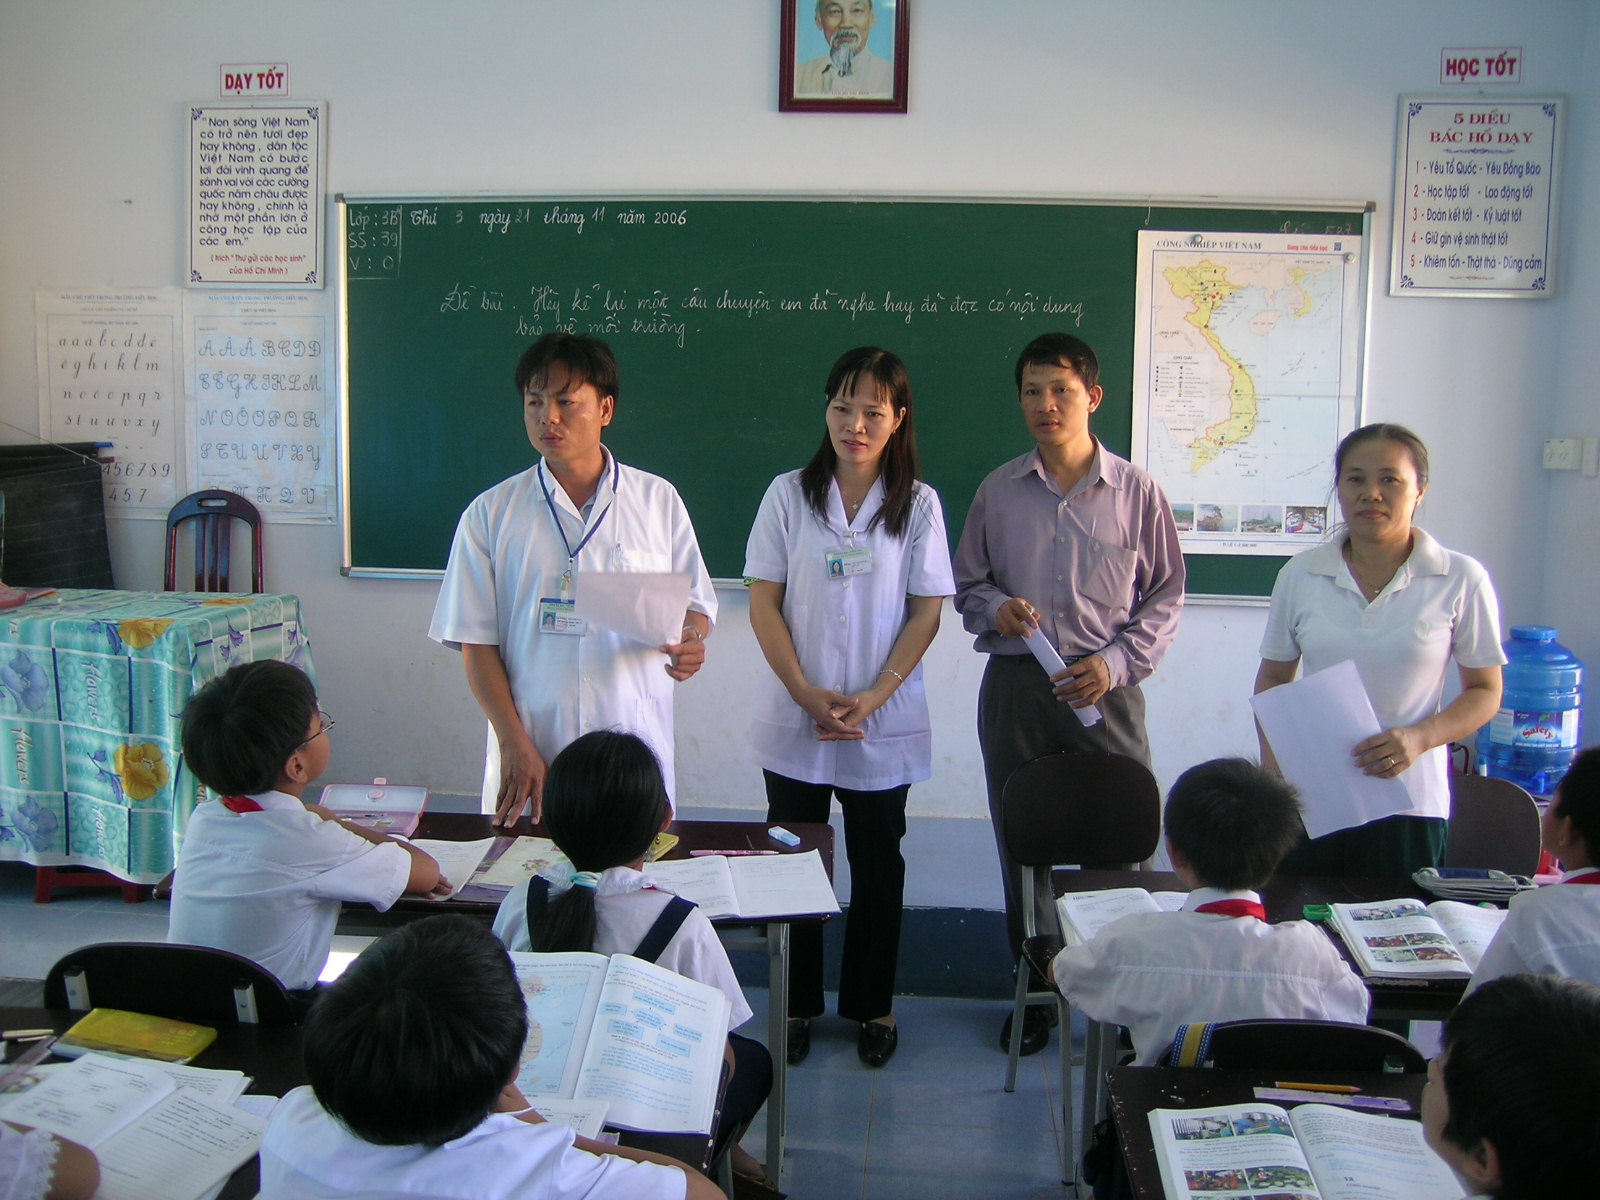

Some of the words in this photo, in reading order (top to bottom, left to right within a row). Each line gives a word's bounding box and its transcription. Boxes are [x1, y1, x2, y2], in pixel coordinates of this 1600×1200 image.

[1446, 58, 1479, 81] HỌC
[1485, 51, 1516, 77] TỐT
[225, 73, 253, 94] DẠY
[257, 66, 284, 90] TỐT
[261, 117, 281, 128] Việt
[285, 117, 309, 127] Nam
[1454, 112, 1464, 125] 5
[1429, 128, 1463, 143] BÁC
[1498, 132, 1533, 146] DẠY
[200, 142, 219, 152] hay
[200, 154, 221, 164] Việt
[229, 154, 254, 163] Nam
[259, 166, 291, 176] quang
[224, 178, 238, 187] vai
[1414, 184, 1419, 198] 2
[1427, 185, 1442, 200] Học
[1485, 185, 1499, 199] Lao
[200, 201, 219, 212] hay
[455, 210, 464, 224] 3
[479, 208, 511, 234] ngày
[515, 208, 530, 223] 21
[543, 206, 585, 234] tháng
[592, 206, 606, 222] 11
[617, 209, 646, 224] năm
[654, 209, 688, 225] 2006
[1413, 207, 1418, 221] 3
[233, 225, 254, 235] học
[348, 232, 367, 248] SS
[1411, 232, 1416, 244] 4
[1242, 242, 1262, 250] NAM
[349, 256, 360, 270] V
[1410, 254, 1415, 267] 5
[780, 299, 802, 310] em
[883, 291, 915, 324] hay
[1042, 296, 1085, 327] dung
